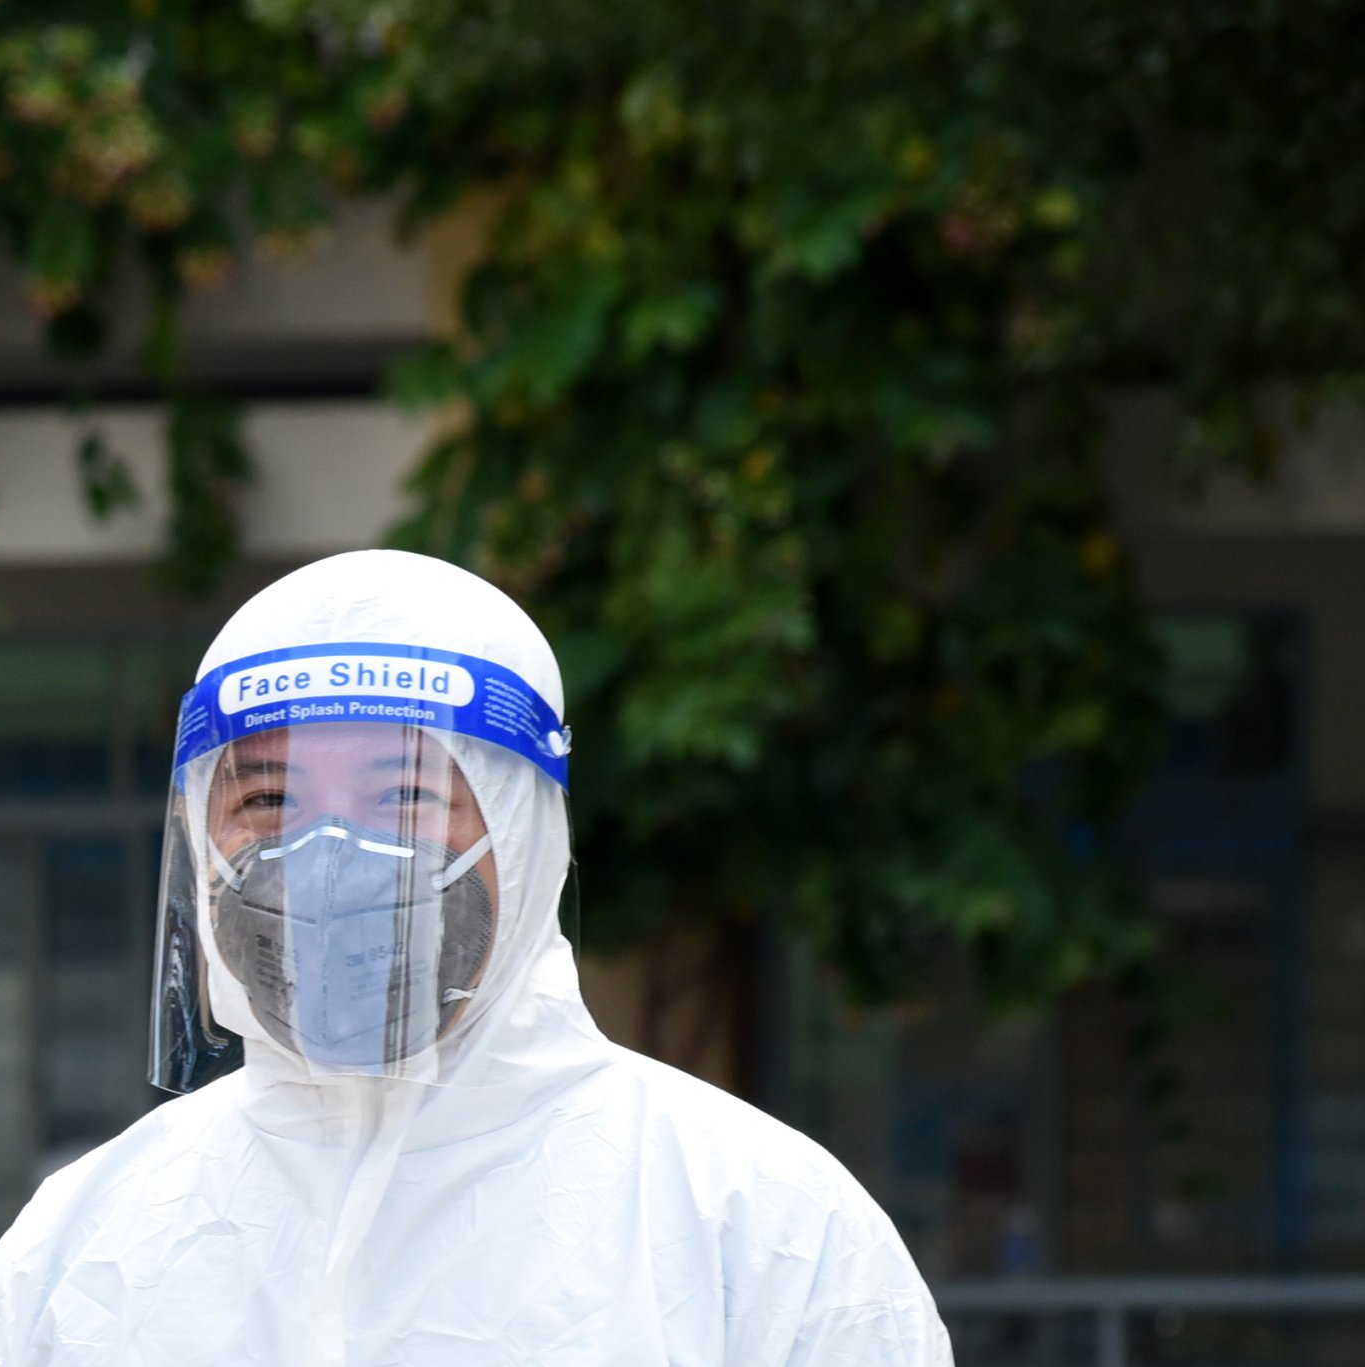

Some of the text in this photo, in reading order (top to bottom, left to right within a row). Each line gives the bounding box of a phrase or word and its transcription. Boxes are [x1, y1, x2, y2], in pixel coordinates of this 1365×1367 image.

[238, 661, 450, 702] Face Shield
[244, 701, 435, 728] Direct Splash Protection
